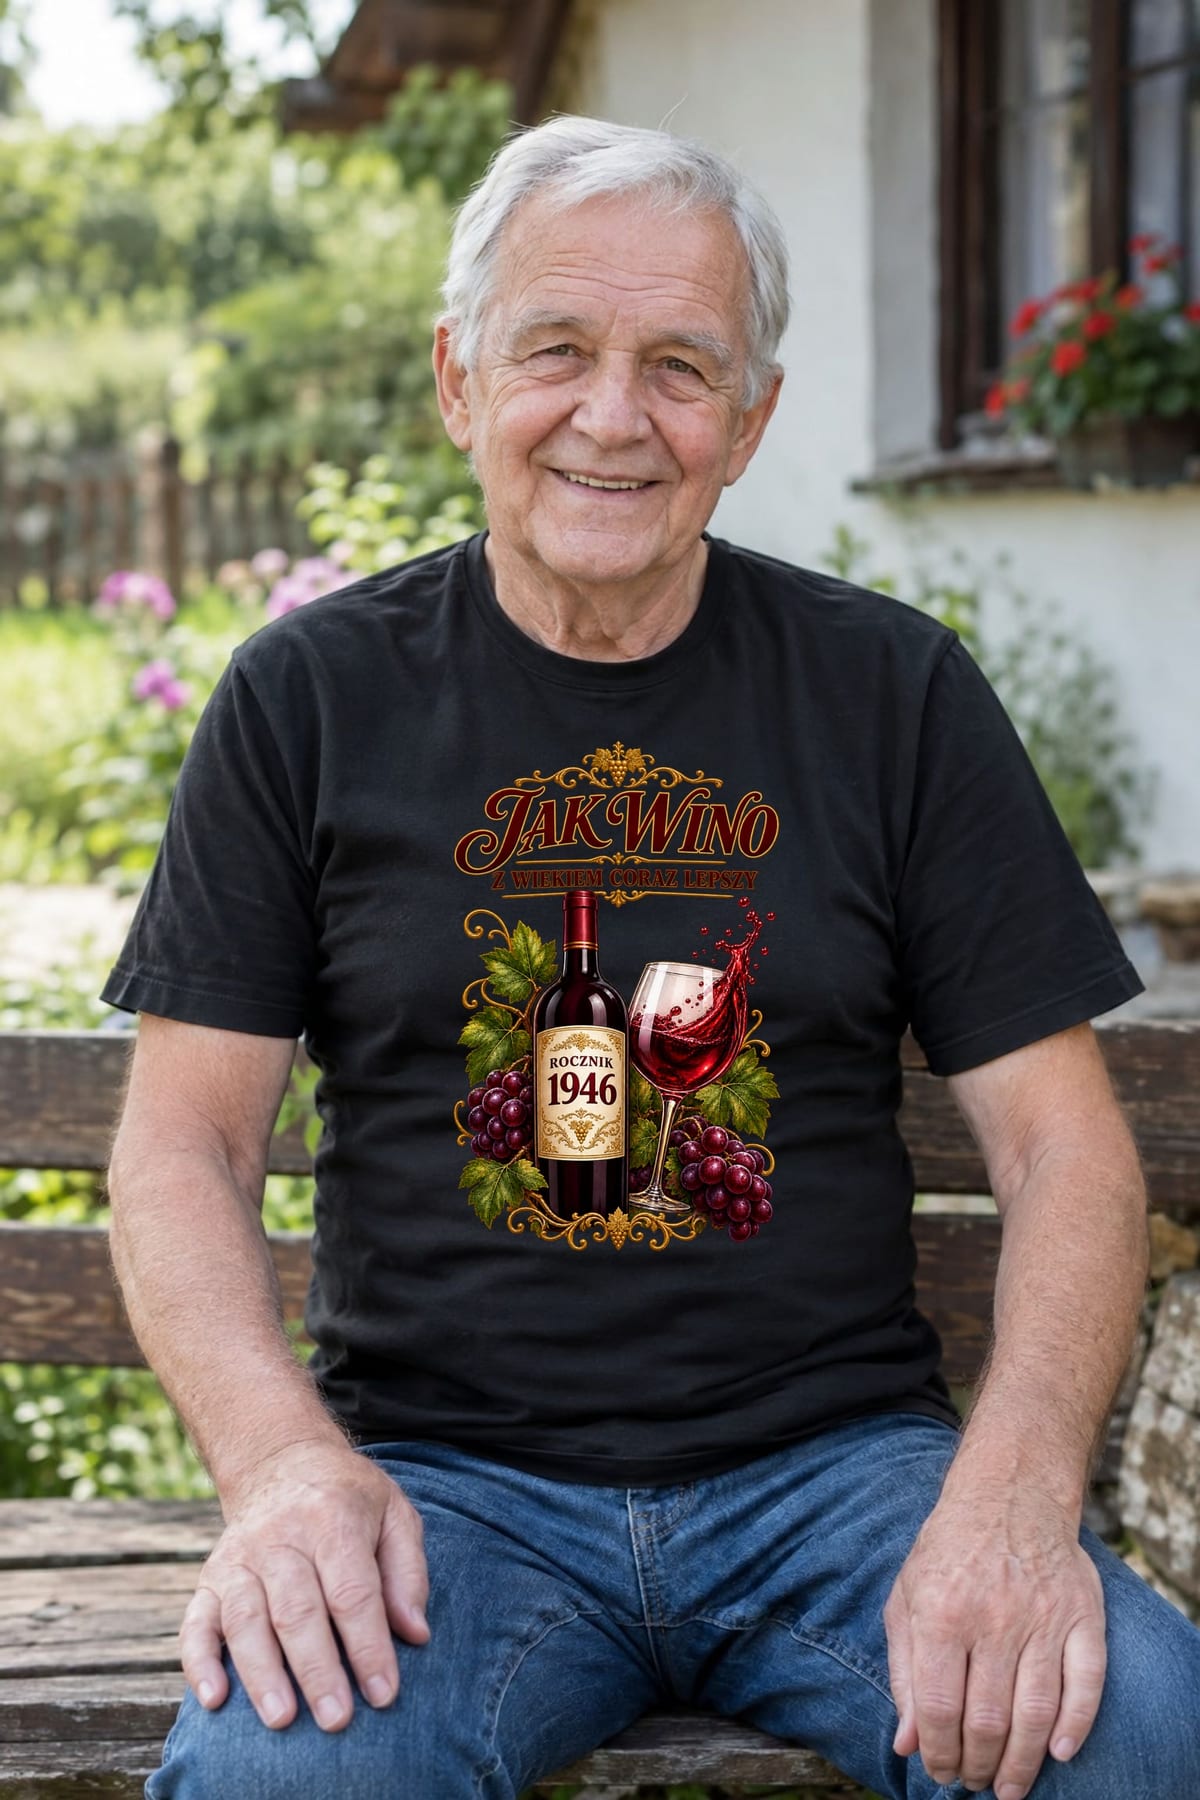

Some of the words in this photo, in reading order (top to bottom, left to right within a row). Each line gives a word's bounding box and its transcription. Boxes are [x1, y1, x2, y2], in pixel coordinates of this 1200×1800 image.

[454, 786, 612, 876] JAK
[606, 787, 780, 858] WINO
[491, 870, 506, 889] Z
[512, 868, 604, 889] WIEKIEM
[609, 868, 679, 888] CORAZ
[684, 869, 758, 889] LEPSZY
[550, 1055, 613, 1069] ROCZNIK
[547, 1071, 617, 1106] 1946
